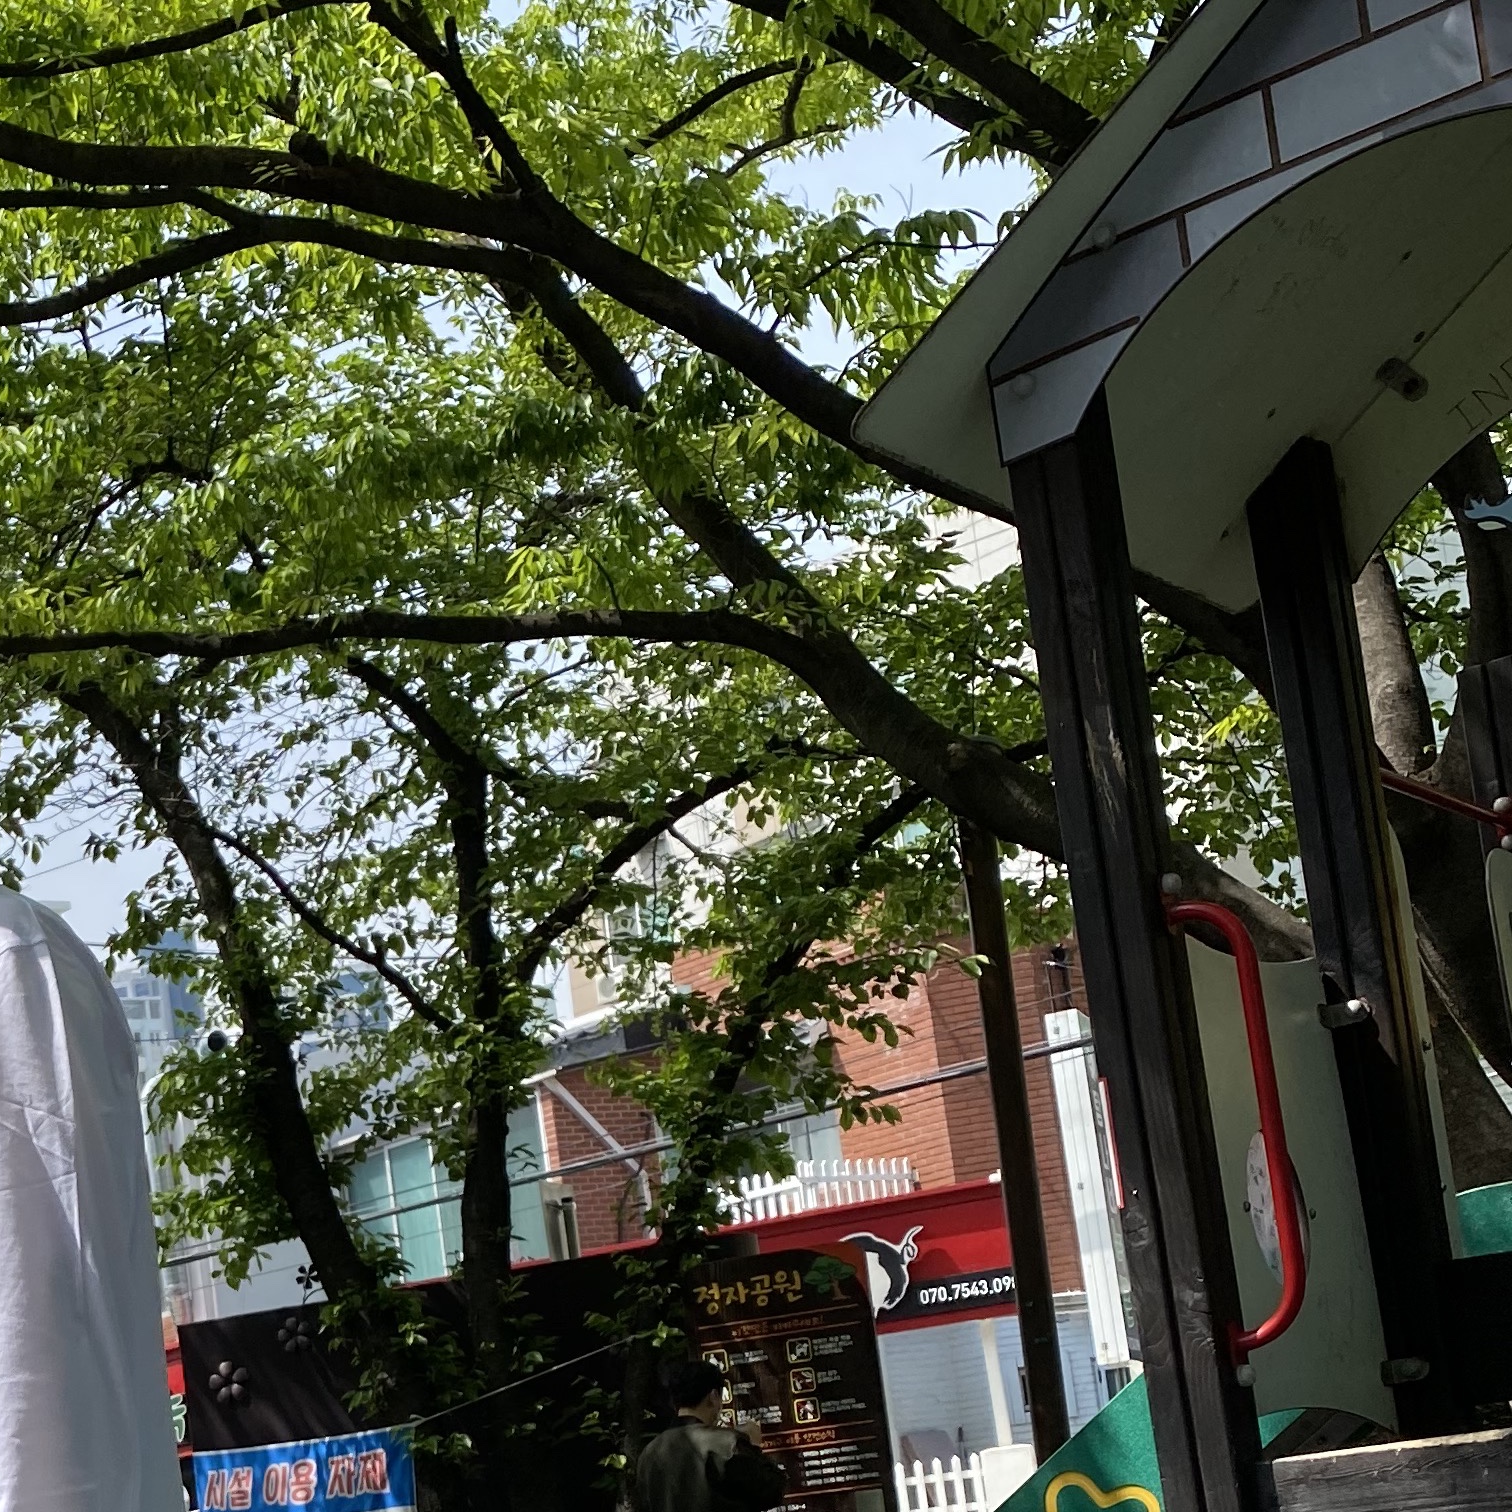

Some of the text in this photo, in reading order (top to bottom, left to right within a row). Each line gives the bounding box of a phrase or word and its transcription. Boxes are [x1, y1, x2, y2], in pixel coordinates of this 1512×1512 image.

[692, 1269, 804, 1315] 정자공원
[204, 1449, 390, 1511] 시설 이용 자제
